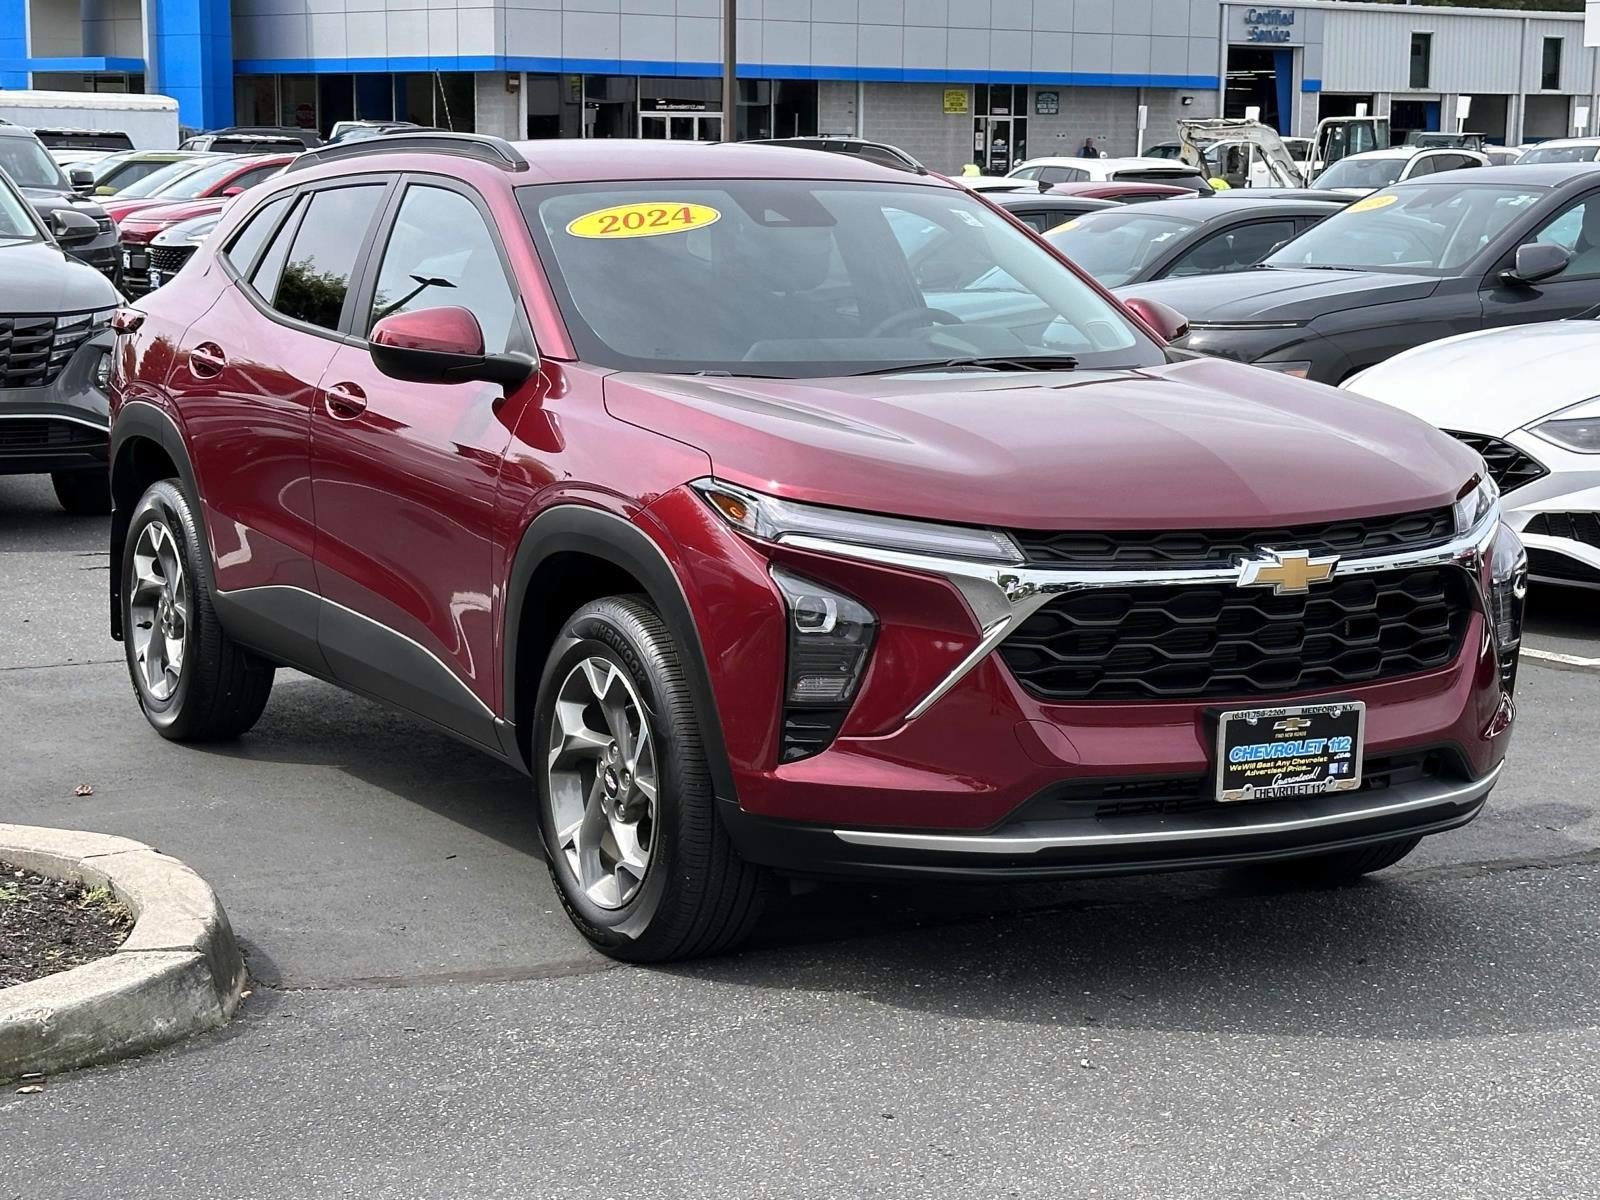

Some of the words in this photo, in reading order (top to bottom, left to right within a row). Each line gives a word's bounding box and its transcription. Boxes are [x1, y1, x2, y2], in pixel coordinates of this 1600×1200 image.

[1247, 8, 1294, 25] Certified
[1248, 26, 1290, 43] Service
[598, 206, 696, 234] 2024
[1251, 709, 1286, 719] 758-2200
[1229, 738, 1327, 762] CHEVROLET
[1327, 736, 1352, 753] 112
[1333, 752, 1351, 760] .com
[1230, 764, 1242, 772] We
[1242, 762, 1256, 770] Will
[1256, 761, 1274, 769] Beat
[1291, 756, 1328, 765] Chevrolet
[1244, 766, 1287, 777] Advertised
[1254, 785, 1312, 799] CHEVROLET
[1312, 782, 1326, 794] 112
